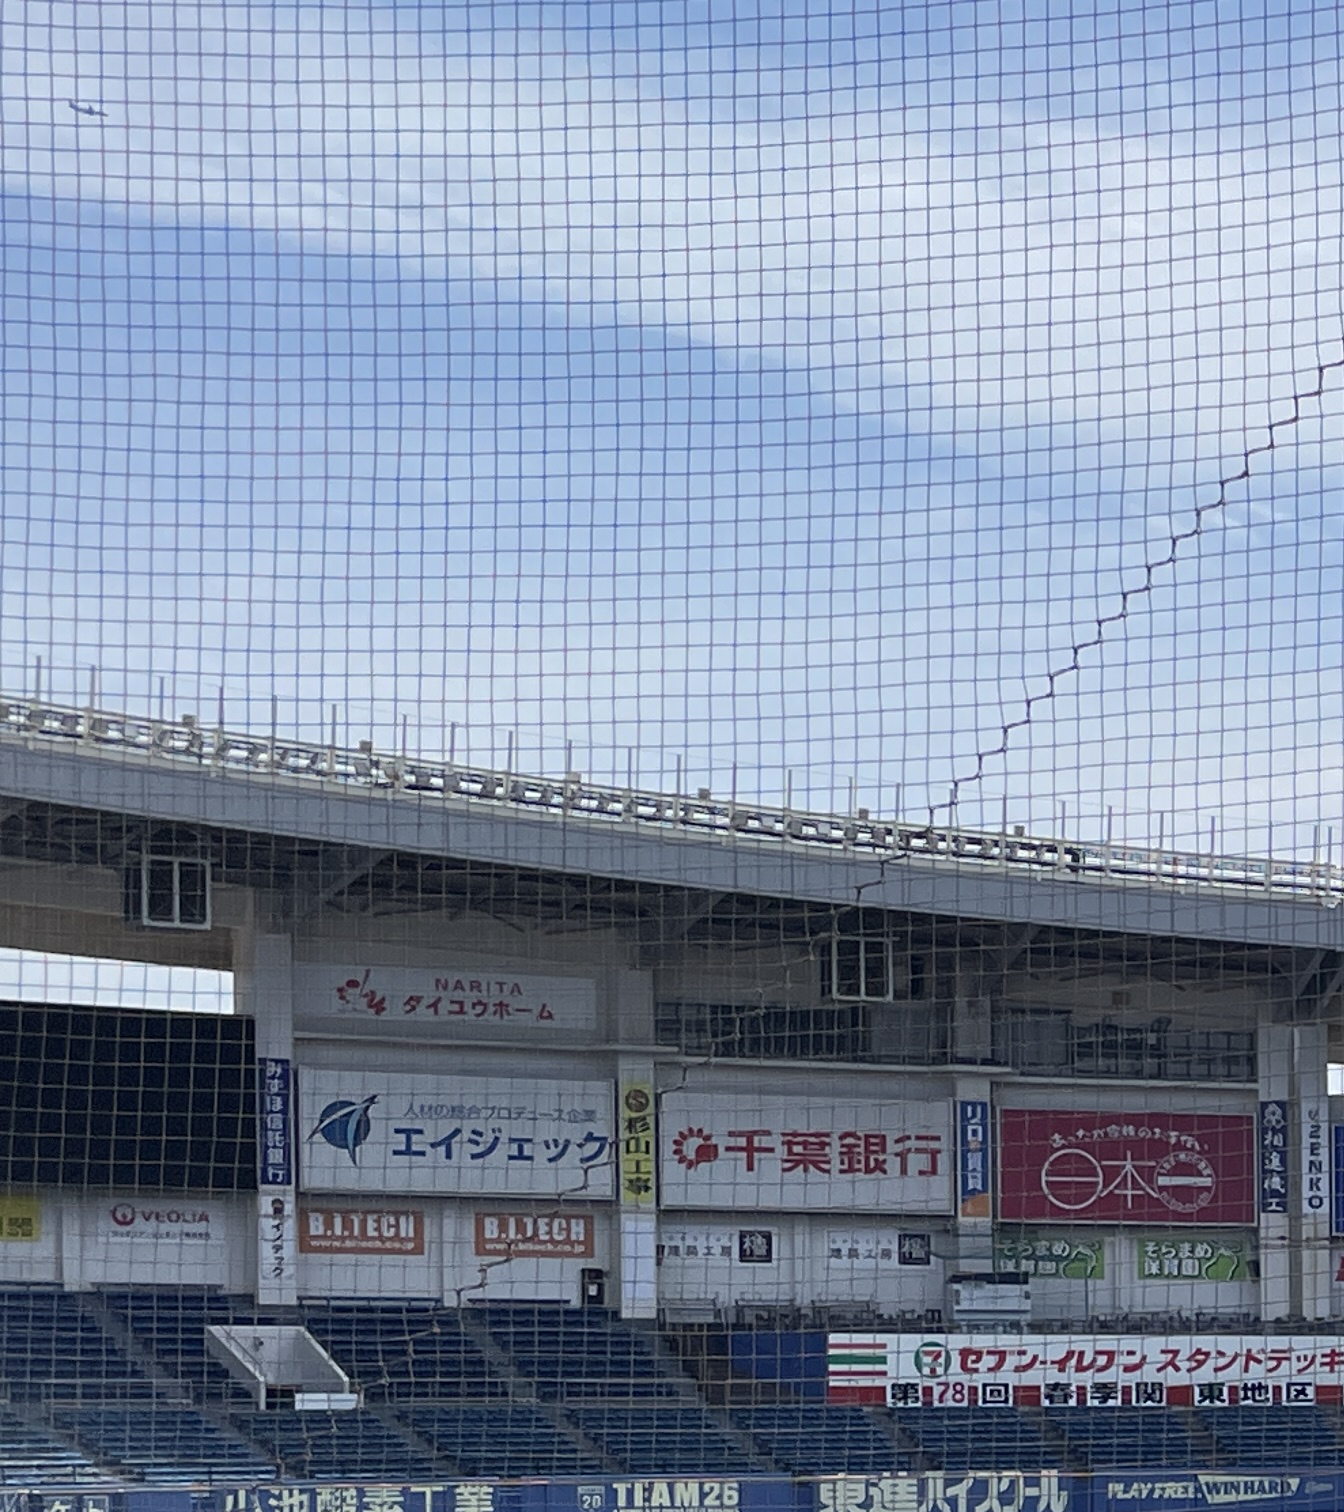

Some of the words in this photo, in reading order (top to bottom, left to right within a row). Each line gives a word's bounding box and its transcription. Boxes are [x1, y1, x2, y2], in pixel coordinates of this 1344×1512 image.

[435, 978, 523, 996] NARITA
[403, 995, 555, 1021] ダイユウホーム
[392, 1127, 609, 1164] エイジェック
[724, 1129, 942, 1176] 千葉銀行
[1308, 1124, 1323, 1209] ZENKO
[142, 1210, 209, 1223] VEOLIA
[308, 1211, 415, 1238] B.I.TECH
[1145, 1240, 1213, 1258] そらまめ
[1108, 1482, 1151, 1499] PLAY
[1205, 1480, 1241, 1497] WIN
